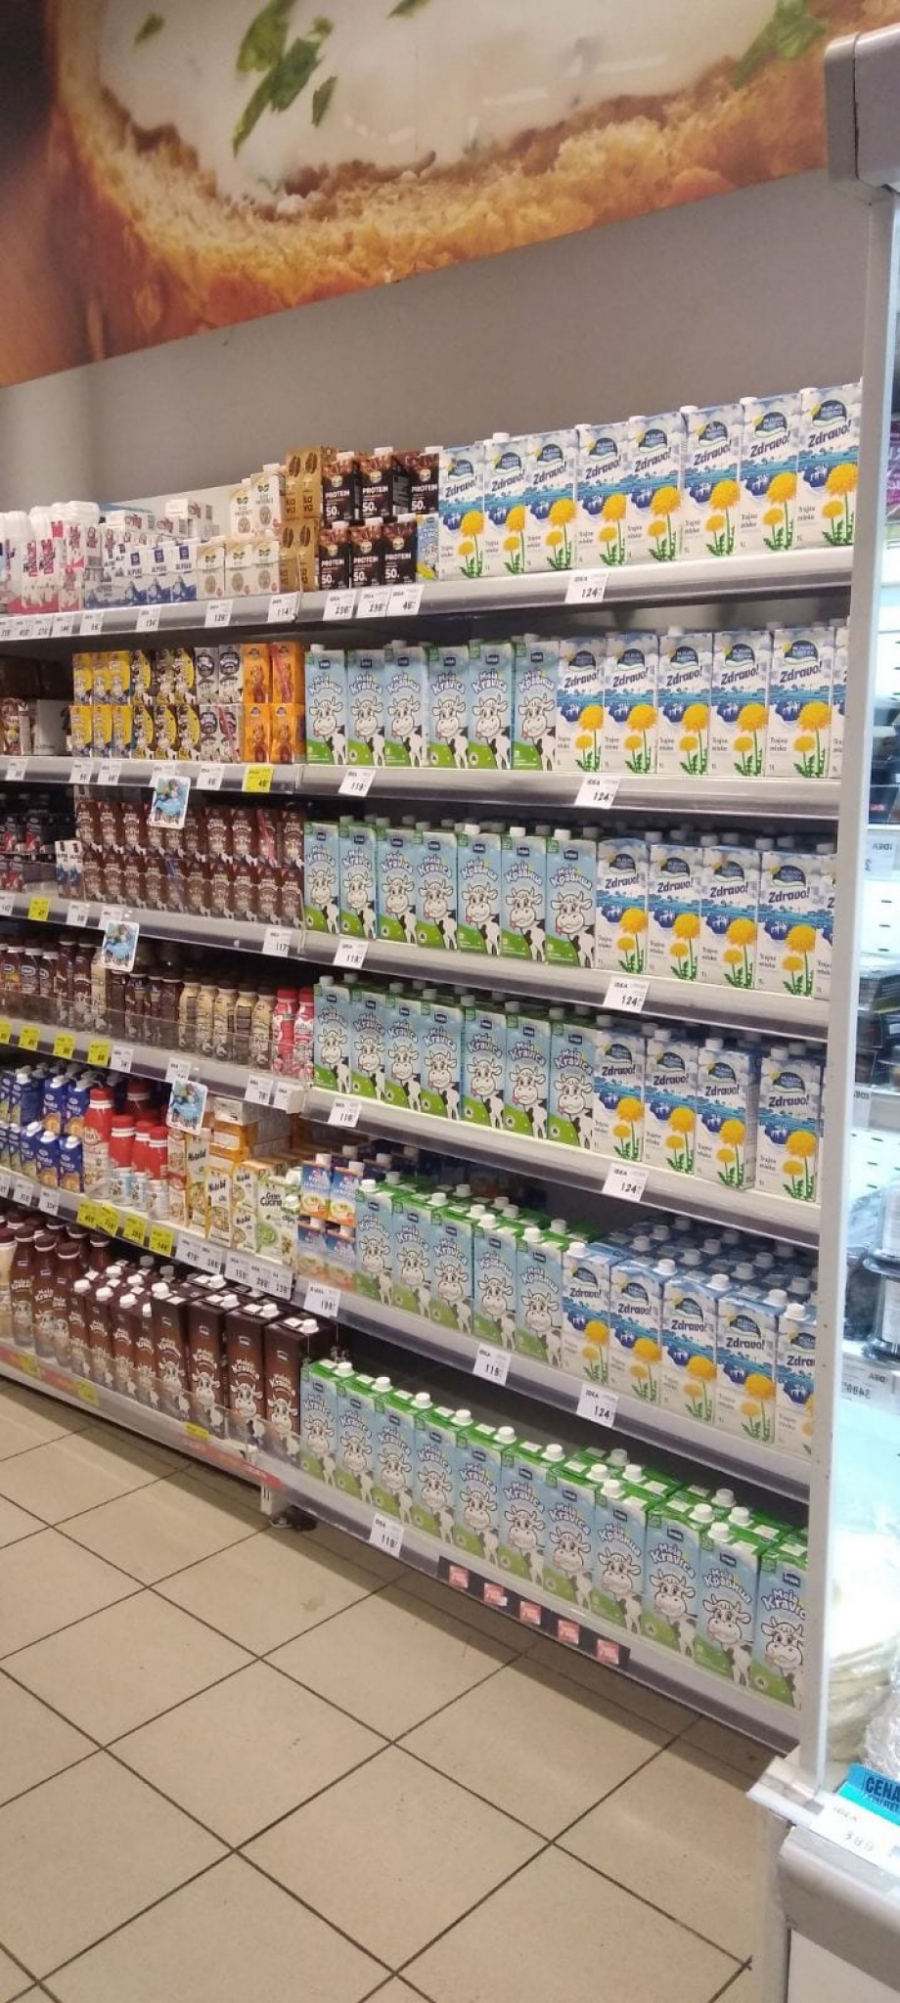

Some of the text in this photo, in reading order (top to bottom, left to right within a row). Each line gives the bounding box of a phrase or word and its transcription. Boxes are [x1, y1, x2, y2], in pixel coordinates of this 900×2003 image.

[808, 420, 852, 449] Zdravo!
[751, 430, 791, 458] Zdravo!
[635, 447, 672, 473] Zdravo!
[694, 441, 732, 466] Zdravo!
[533, 462, 567, 485] Zdravo!
[586, 458, 622, 481] Zdravo!
[411, 484, 438, 493] PROTEIN
[491, 469, 525, 492] Zdravo!
[325, 489, 350, 498] PROTEIN
[362, 486, 389, 495] PROTEIN
[321, 559, 345, 567] PROTEIN
[353, 556, 379, 565] PROTEIN
[384, 552, 412, 561] PROTEIN
[581, 587, 598, 599] 124
[564, 665, 599, 689] Zdravo!
[612, 664, 648, 688] Zdravo!
[666, 665, 702, 687] Zdravo!
[720, 664, 759, 687] Zdravo!
[780, 660, 822, 684] Zdravo!
[593, 791, 611, 801] 124
[605, 875, 640, 890] Zdravo!
[657, 877, 694, 894] Zdravo!
[710, 881, 749, 899] Zdravo!
[768, 886, 810, 905] Zdravo!
[622, 994, 638, 1007] 124
[602, 1064, 636, 1077] Zdravo!
[654, 1073, 689, 1087] Zdravo!
[706, 1083, 740, 1098] Zdravo!
[768, 1094, 809, 1108] Zdravo!
[621, 1182, 637, 1194] 124
[594, 1405, 609, 1419] 124
[865, 1777, 900, 1804] CENA
